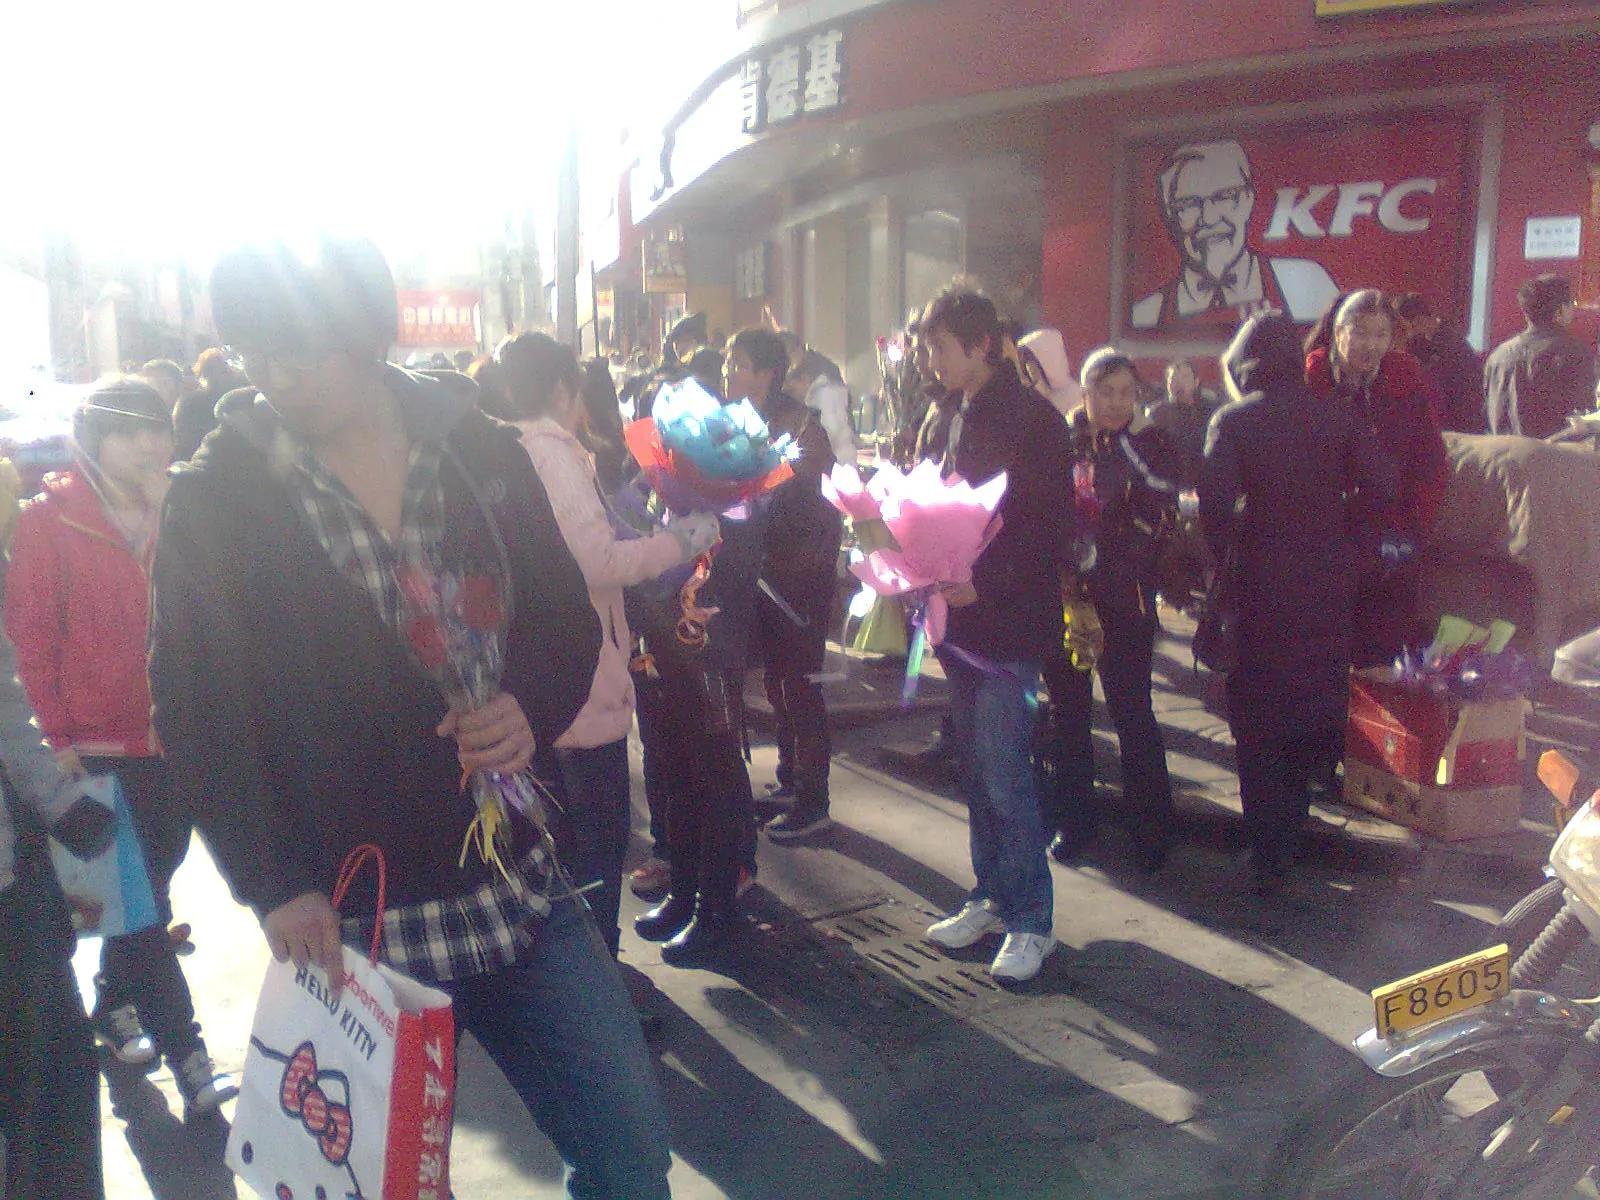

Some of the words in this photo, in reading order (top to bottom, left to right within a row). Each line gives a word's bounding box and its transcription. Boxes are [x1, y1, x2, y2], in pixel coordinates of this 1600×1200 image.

[1263, 178, 1437, 240] KFC
[295, 967, 340, 1016] HELLO
[340, 1007, 377, 1061] KITTY
[1384, 959, 1502, 1031] F8605
